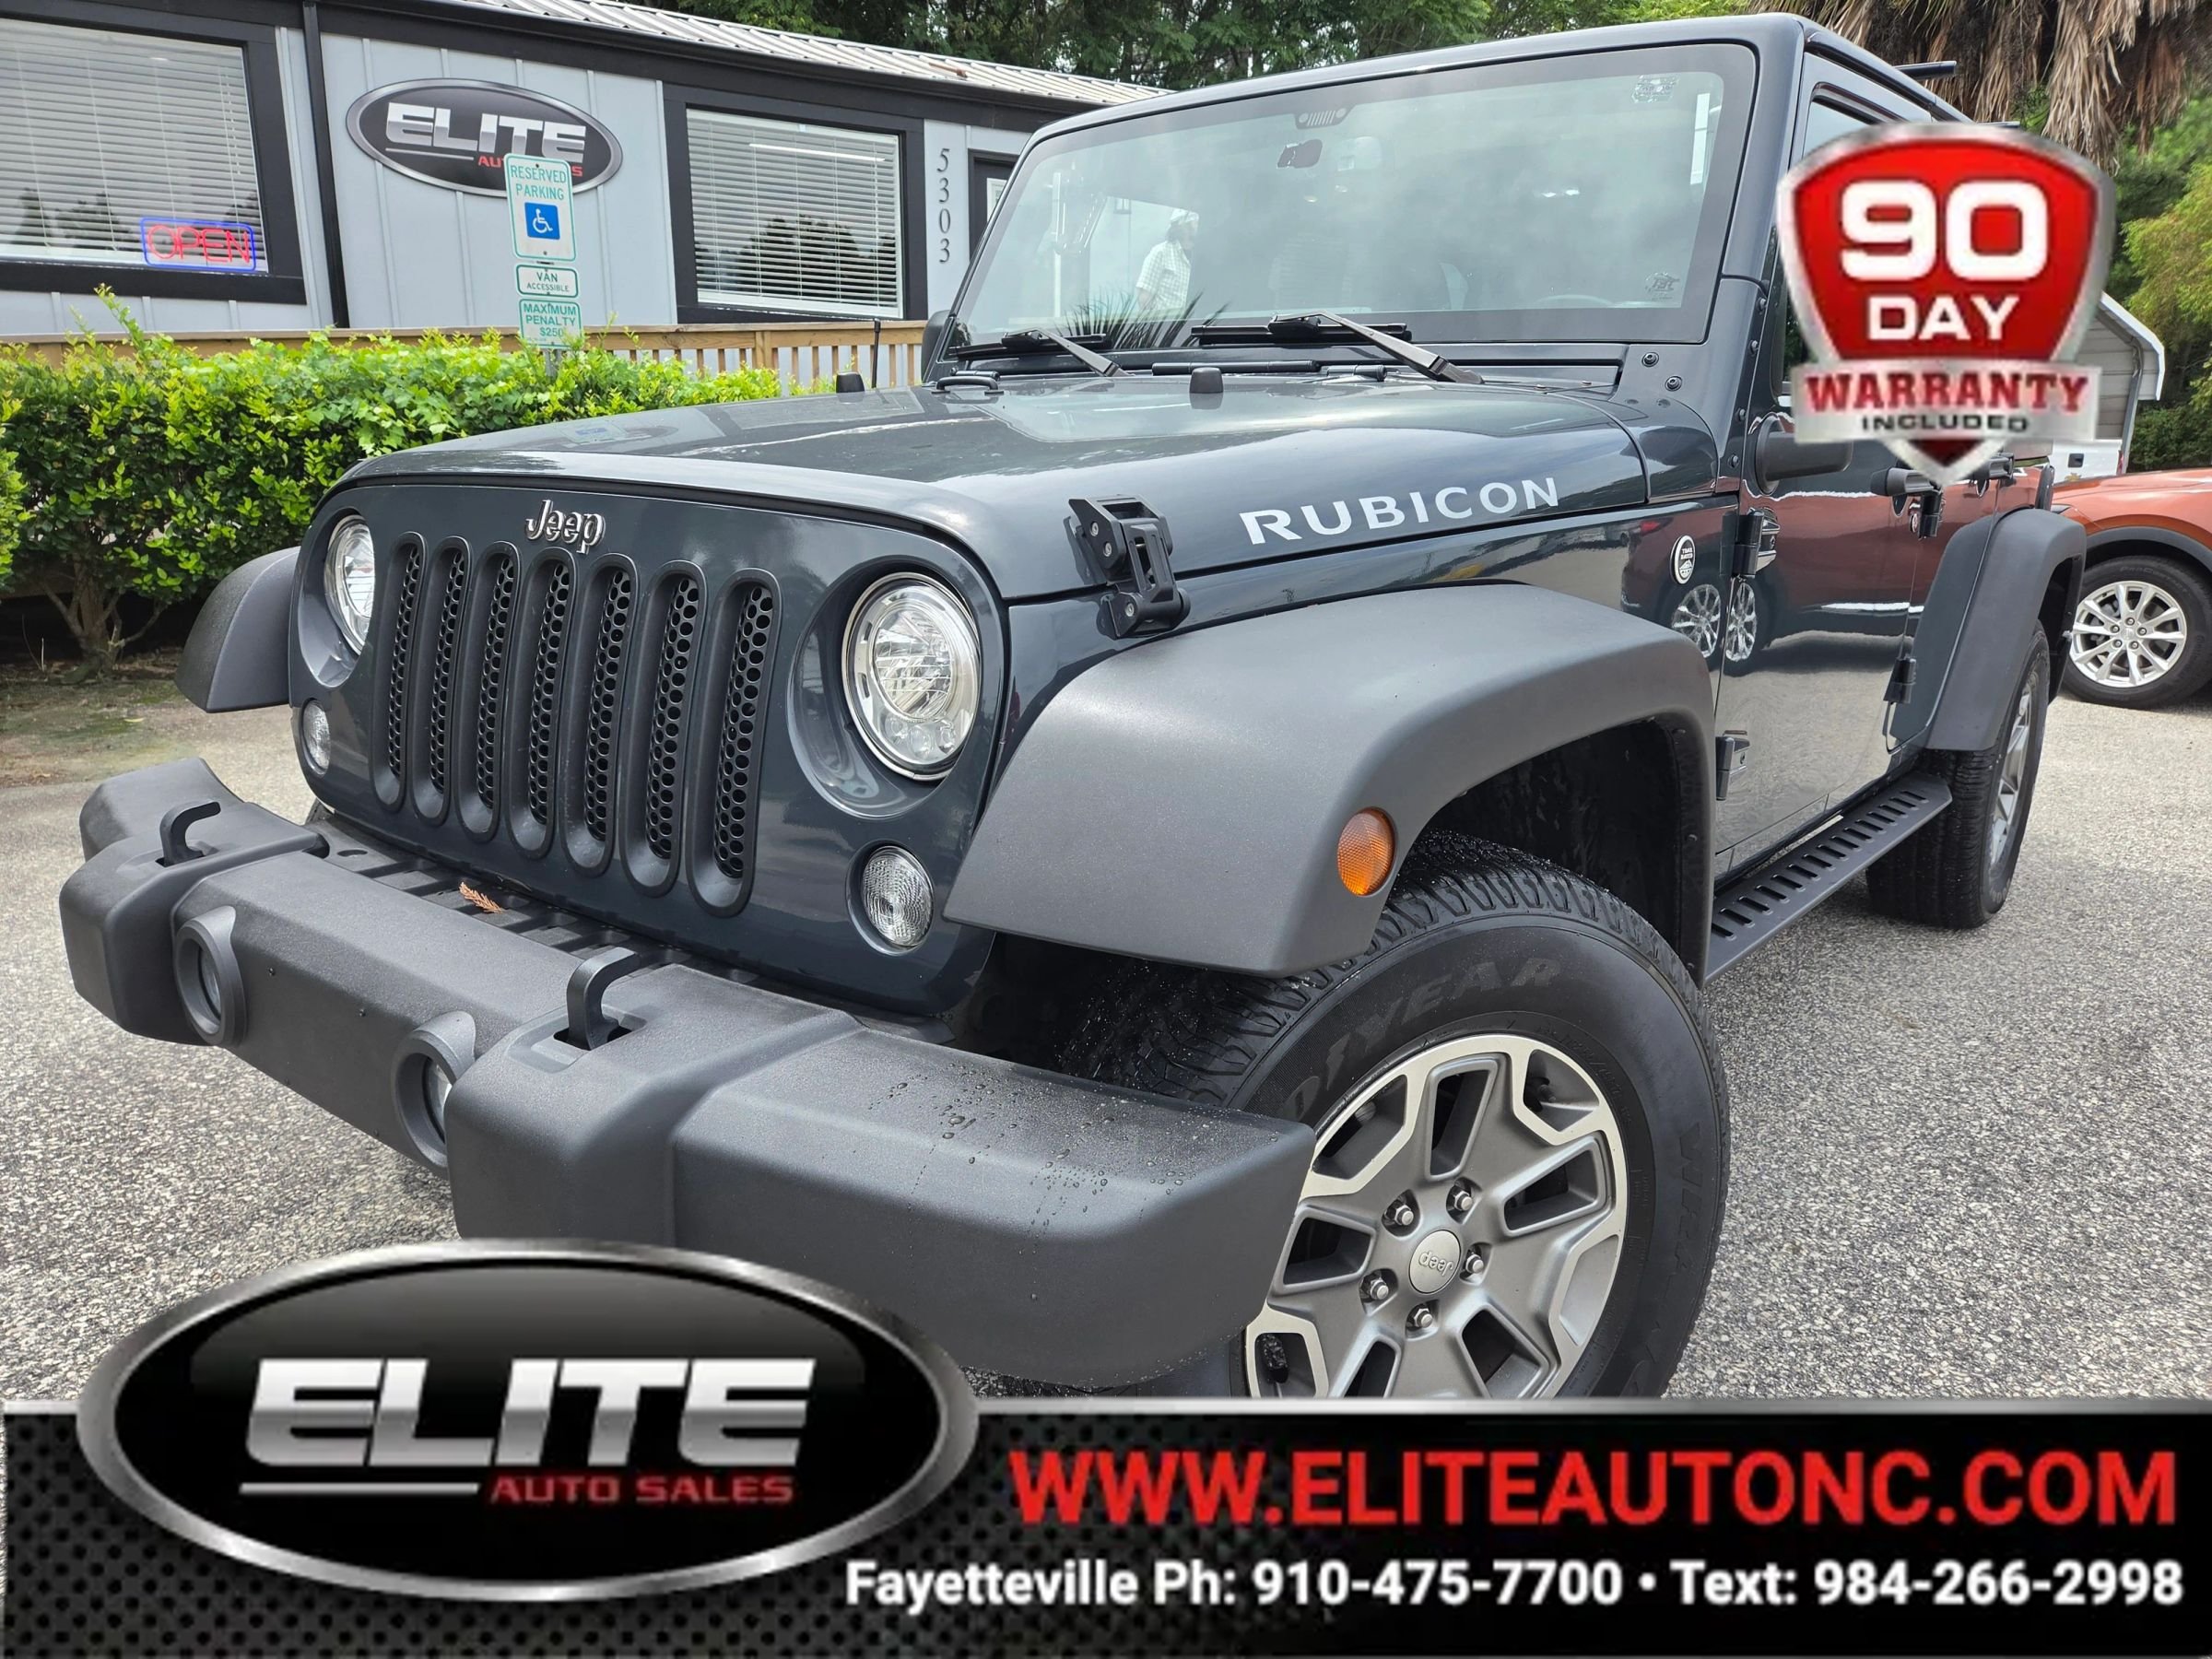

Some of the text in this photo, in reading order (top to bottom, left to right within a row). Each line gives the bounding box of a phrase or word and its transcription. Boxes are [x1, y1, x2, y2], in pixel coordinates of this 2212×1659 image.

[385, 101, 586, 163] ELITE
[511, 165, 567, 183] RESERVED
[515, 183, 564, 200] PARKING
[936, 147, 950, 264] 5303
[147, 224, 250, 263] OPEN
[526, 282, 569, 291] ACCESSIBLE
[536, 272, 558, 282] VAN
[524, 302, 576, 315] MAXIMUM
[525, 314, 575, 326] PENALTY
[1239, 477, 1559, 545] RUBICON
[525, 499, 606, 555] Jeep
[1419, 1251, 1454, 1277] Jeep
